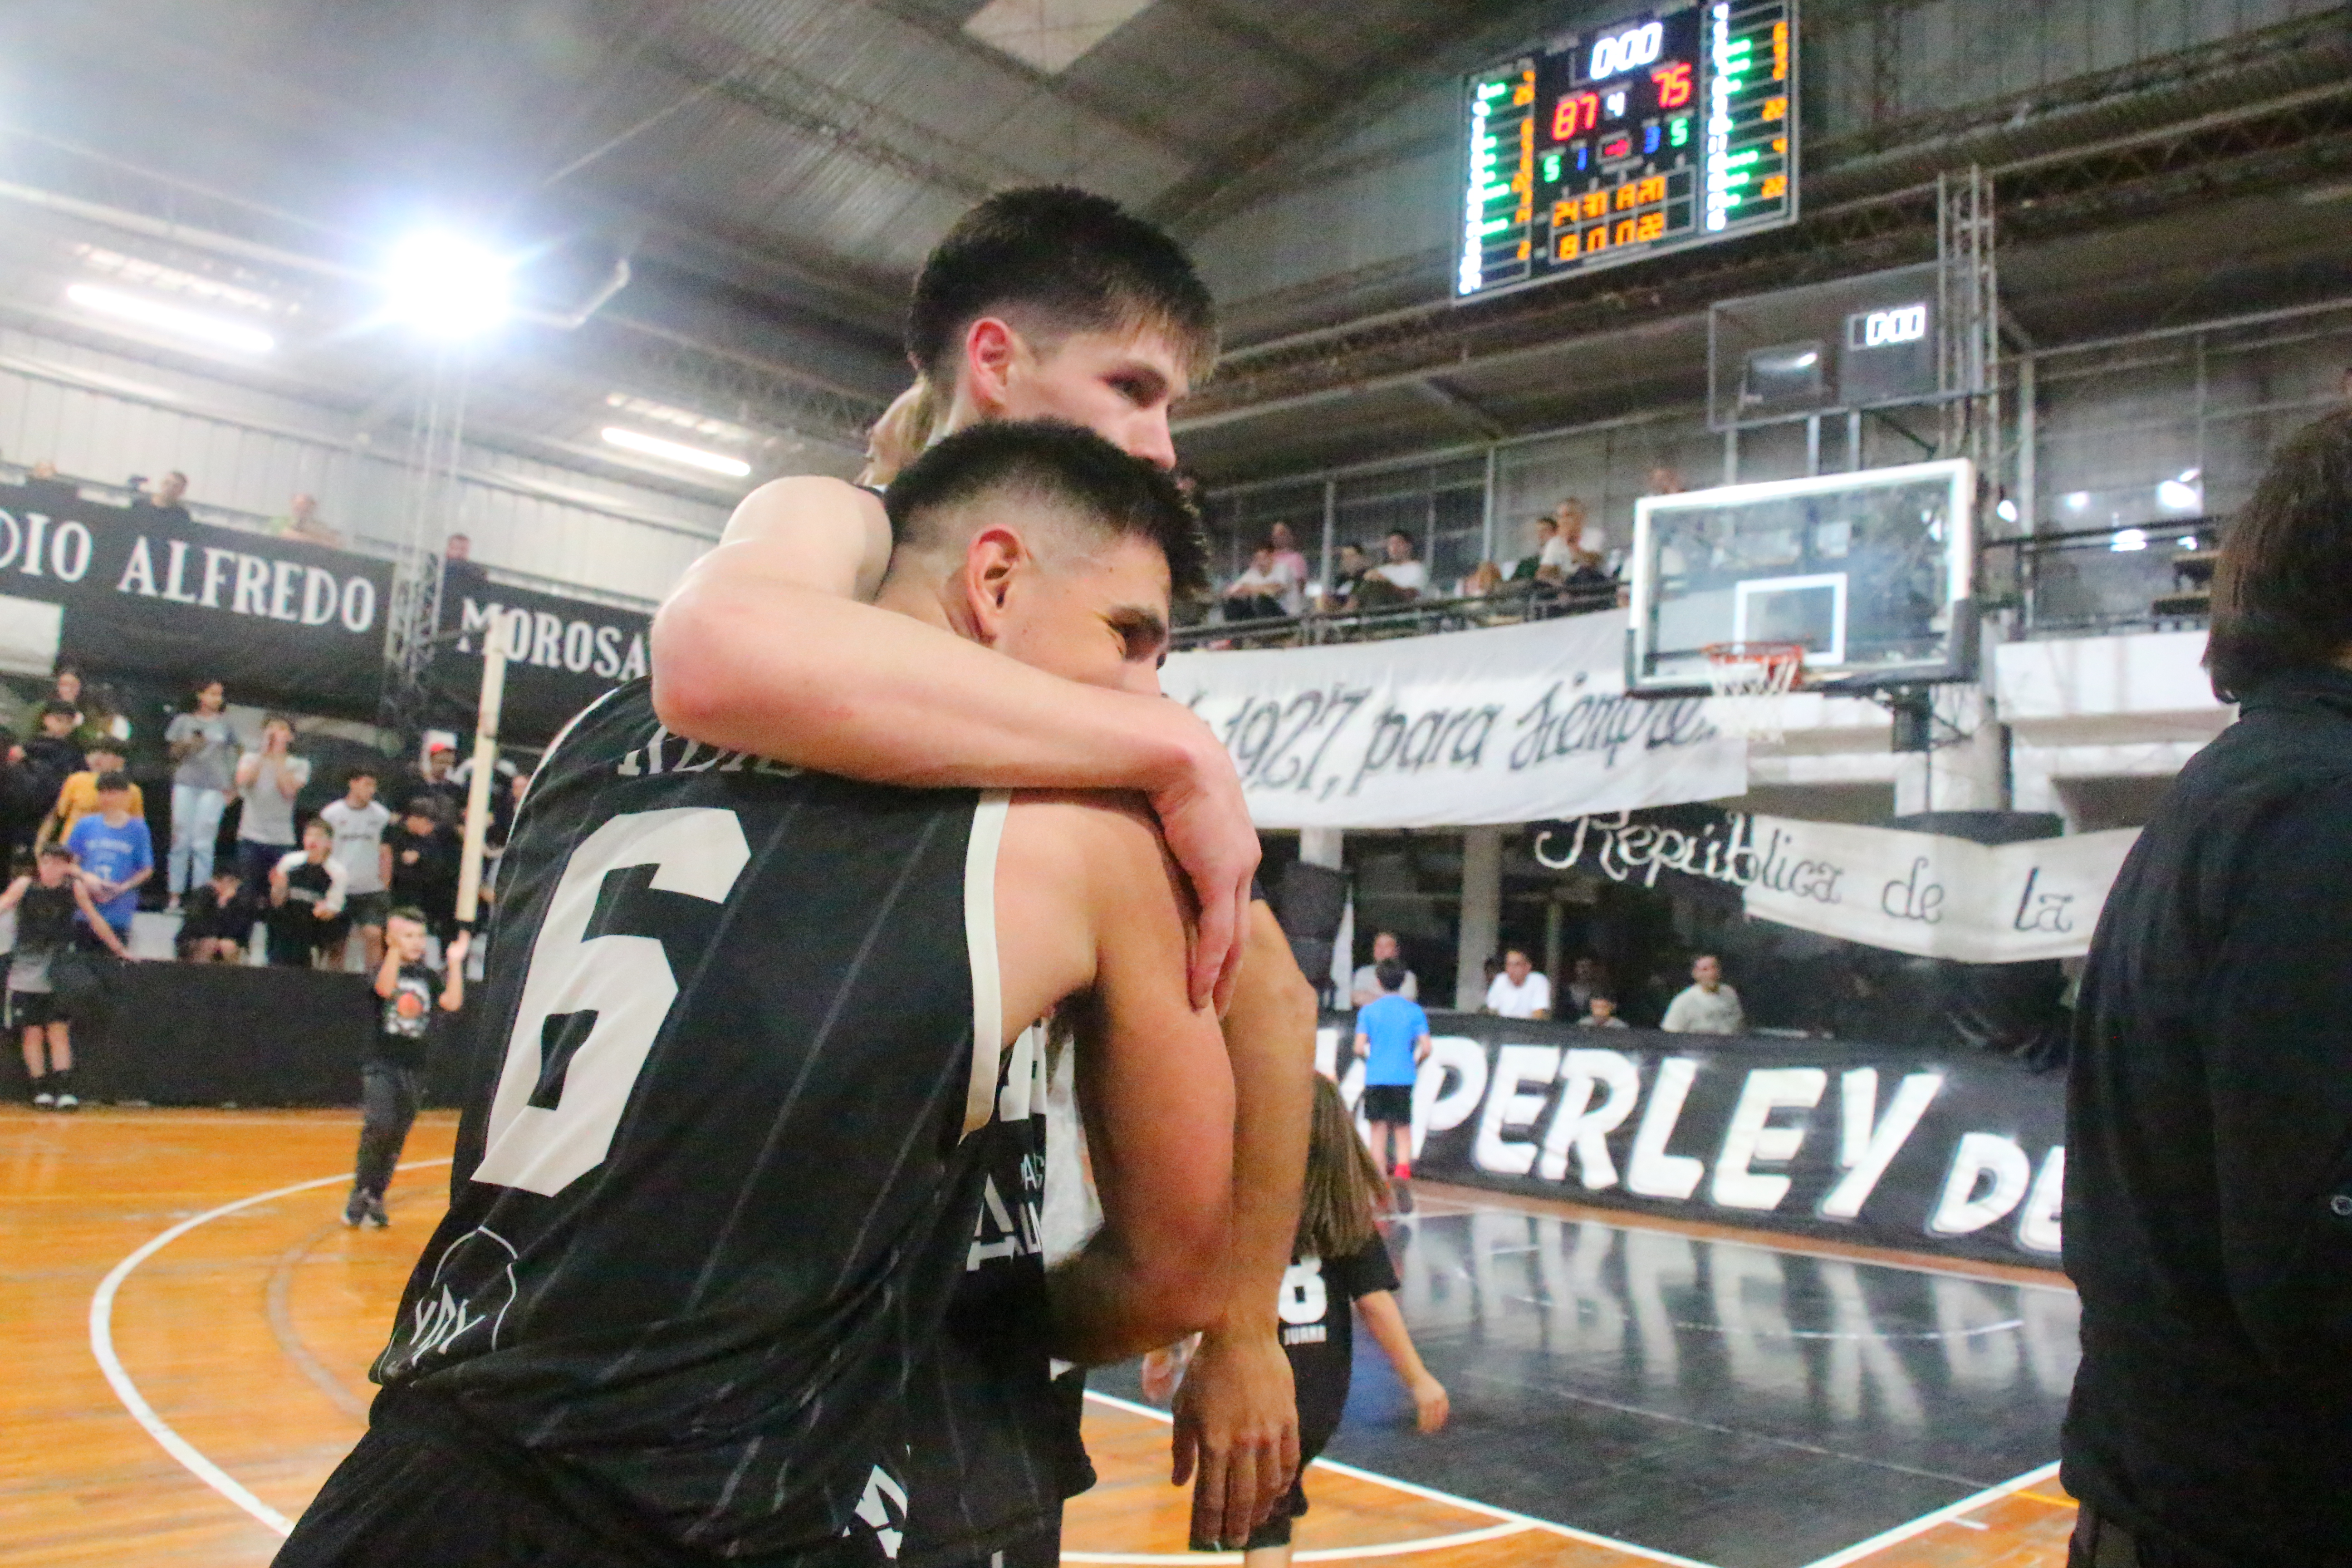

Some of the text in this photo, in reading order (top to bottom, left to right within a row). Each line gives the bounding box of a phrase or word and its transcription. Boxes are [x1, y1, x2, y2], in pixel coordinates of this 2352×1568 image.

[1607, 92, 1626, 117] 4
[1651, 62, 1692, 108] 75
[1552, 93, 1599, 141] 87
[1671, 117, 1689, 147] 5
[1544, 154, 1561, 183] 5
[1577, 147, 1587, 171] 1
[117, 535, 376, 632] ALFREDO
[1346, 703, 1505, 797] para
[1882, 856, 1945, 925] de
[470, 806, 751, 1198] 6
